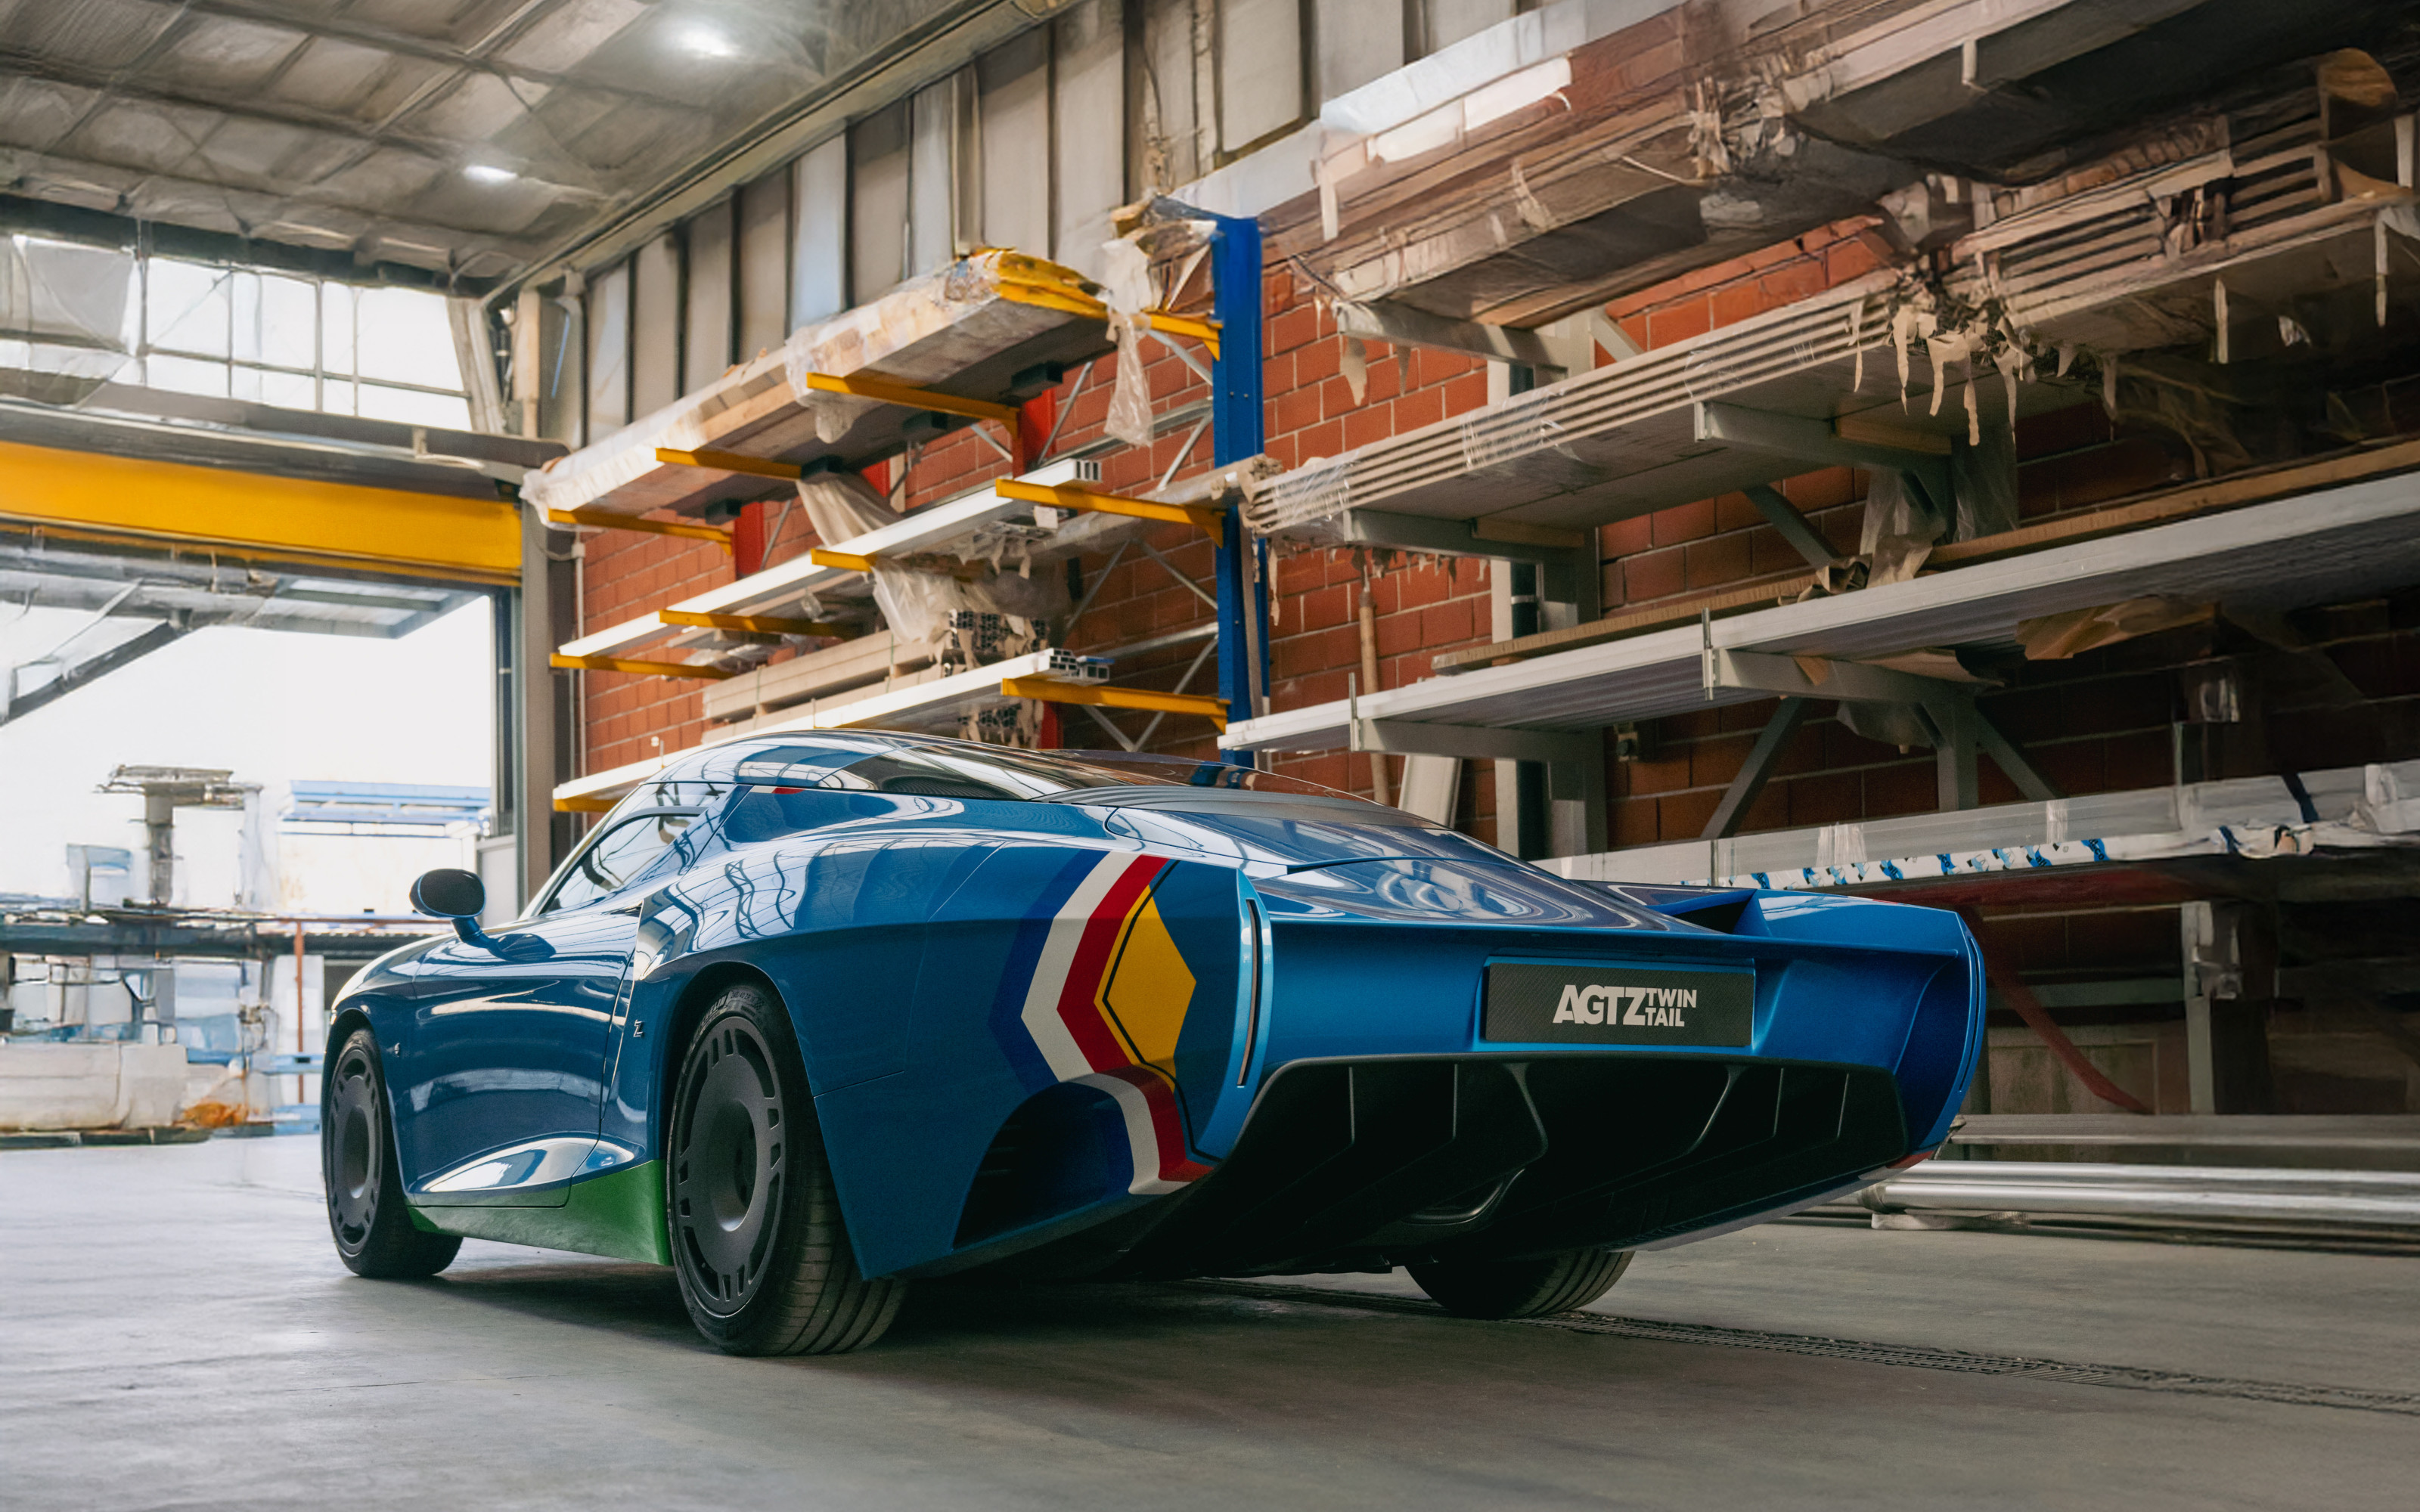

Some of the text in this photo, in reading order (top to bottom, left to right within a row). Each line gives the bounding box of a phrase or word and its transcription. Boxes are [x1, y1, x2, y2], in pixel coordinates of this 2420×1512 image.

[1553, 984, 1646, 1026] AGTZ
[1646, 988, 1697, 1008] TWIN
[1645, 1007, 1685, 1027] TAIL
